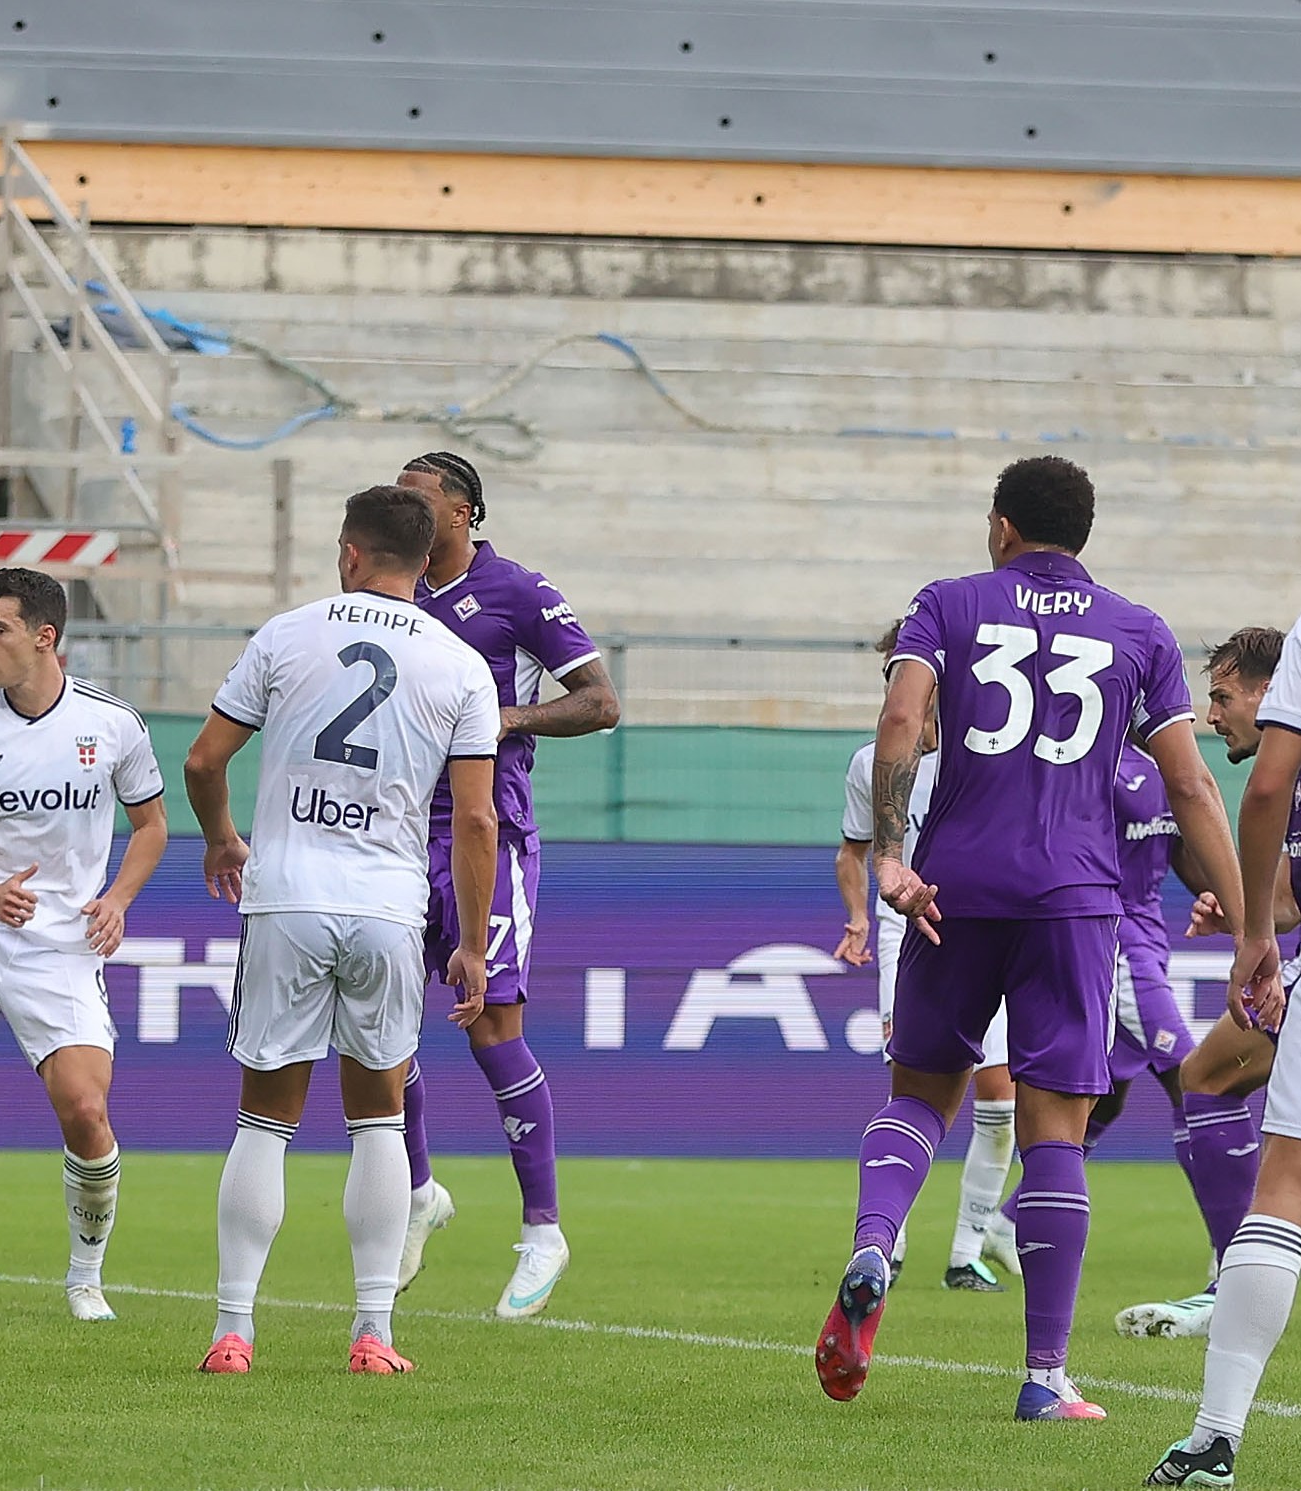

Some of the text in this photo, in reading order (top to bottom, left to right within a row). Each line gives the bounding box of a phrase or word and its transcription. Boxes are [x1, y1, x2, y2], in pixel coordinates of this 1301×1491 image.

[328, 603, 425, 637] KEMPF
[1015, 584, 1093, 616] VIERY
[313, 640, 398, 771] 2
[964, 623, 1114, 765] 33
[291, 786, 380, 832] Uber
[73, 1205, 113, 1223] COMO
